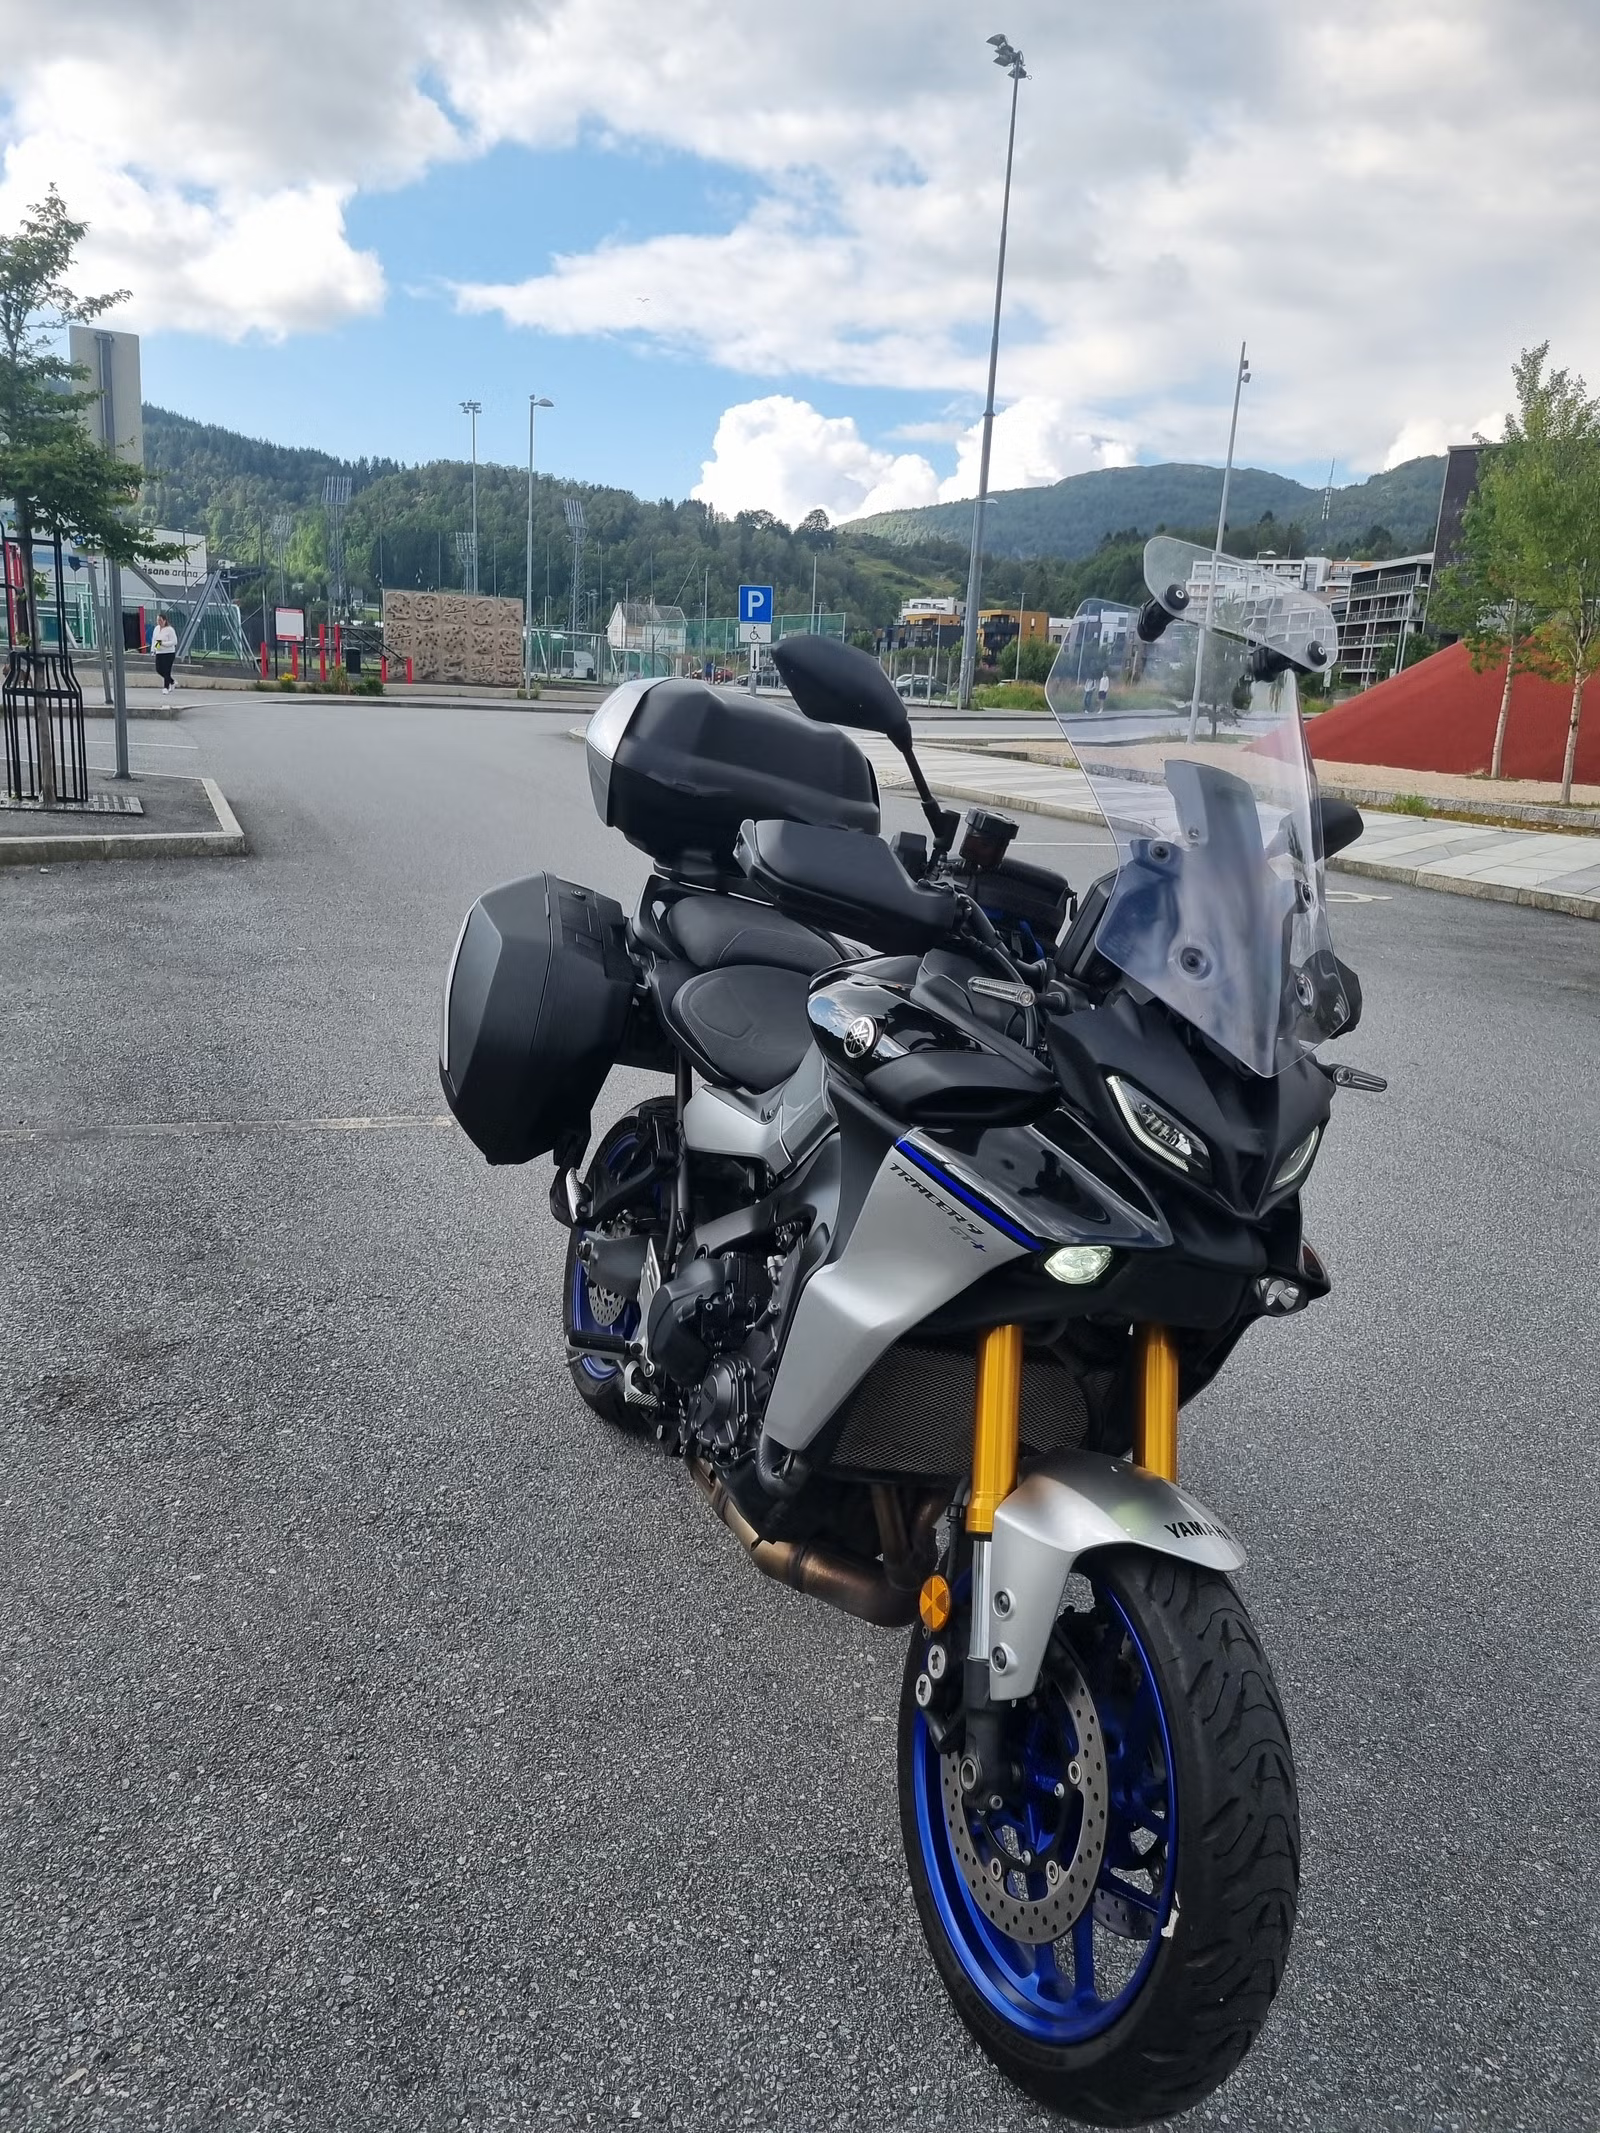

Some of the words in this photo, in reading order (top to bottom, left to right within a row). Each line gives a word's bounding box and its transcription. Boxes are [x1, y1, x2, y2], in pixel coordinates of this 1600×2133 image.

[172, 569, 198, 578] arena
[748, 590, 764, 618] P
[889, 1162, 968, 1224] TRACER
[967, 1223, 984, 1235] 9
